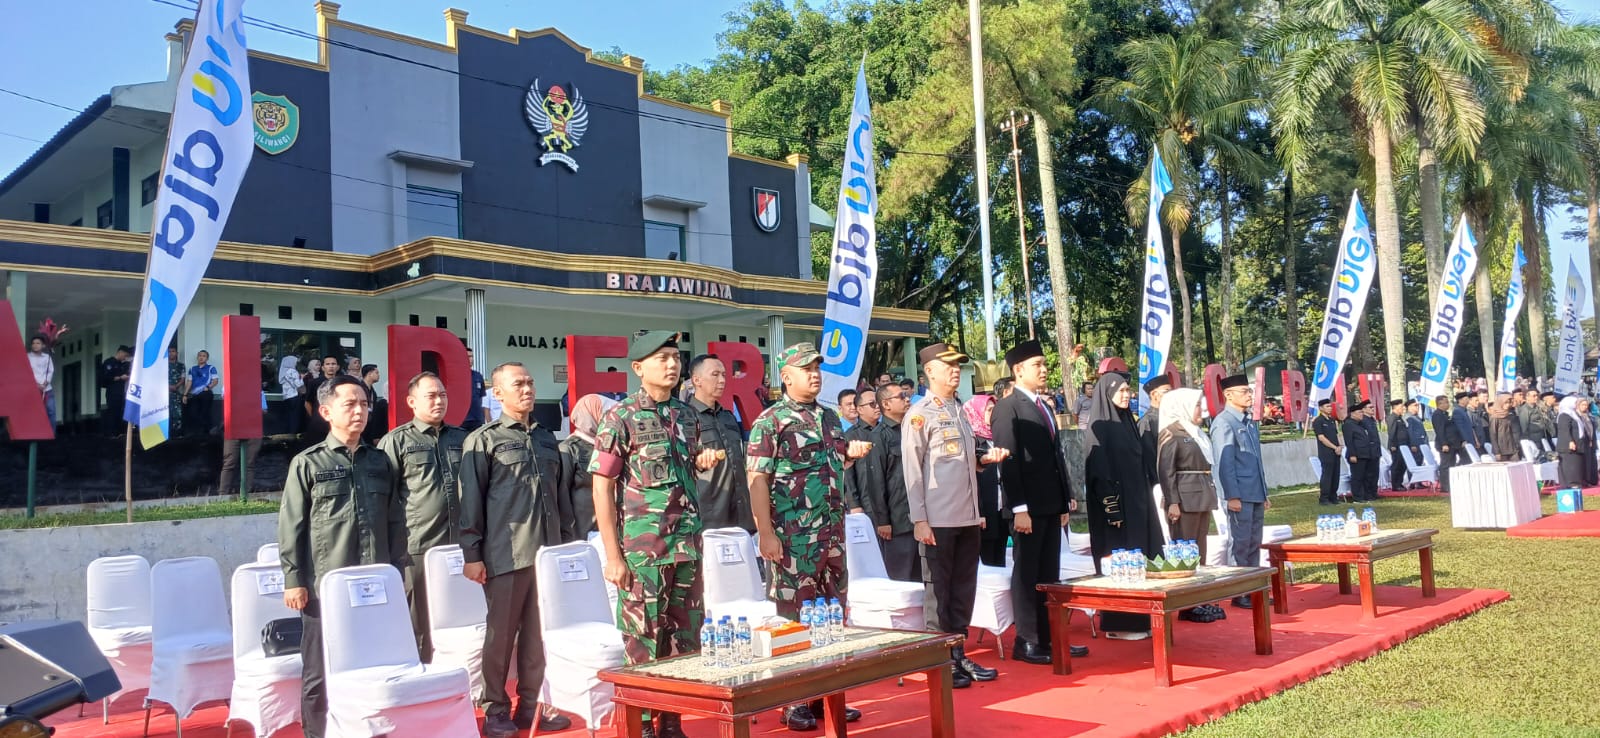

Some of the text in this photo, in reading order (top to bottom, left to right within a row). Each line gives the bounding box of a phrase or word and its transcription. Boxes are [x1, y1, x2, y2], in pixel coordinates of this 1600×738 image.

[155, 129, 224, 260] bjb
[606, 272, 733, 300] BRAJAWIJAYA
[828, 223, 871, 308] bjb
[507, 335, 548, 349] AULA
[1324, 298, 1353, 349] bjb
[1431, 303, 1457, 348] bjb
[1560, 335, 1577, 372] bank
